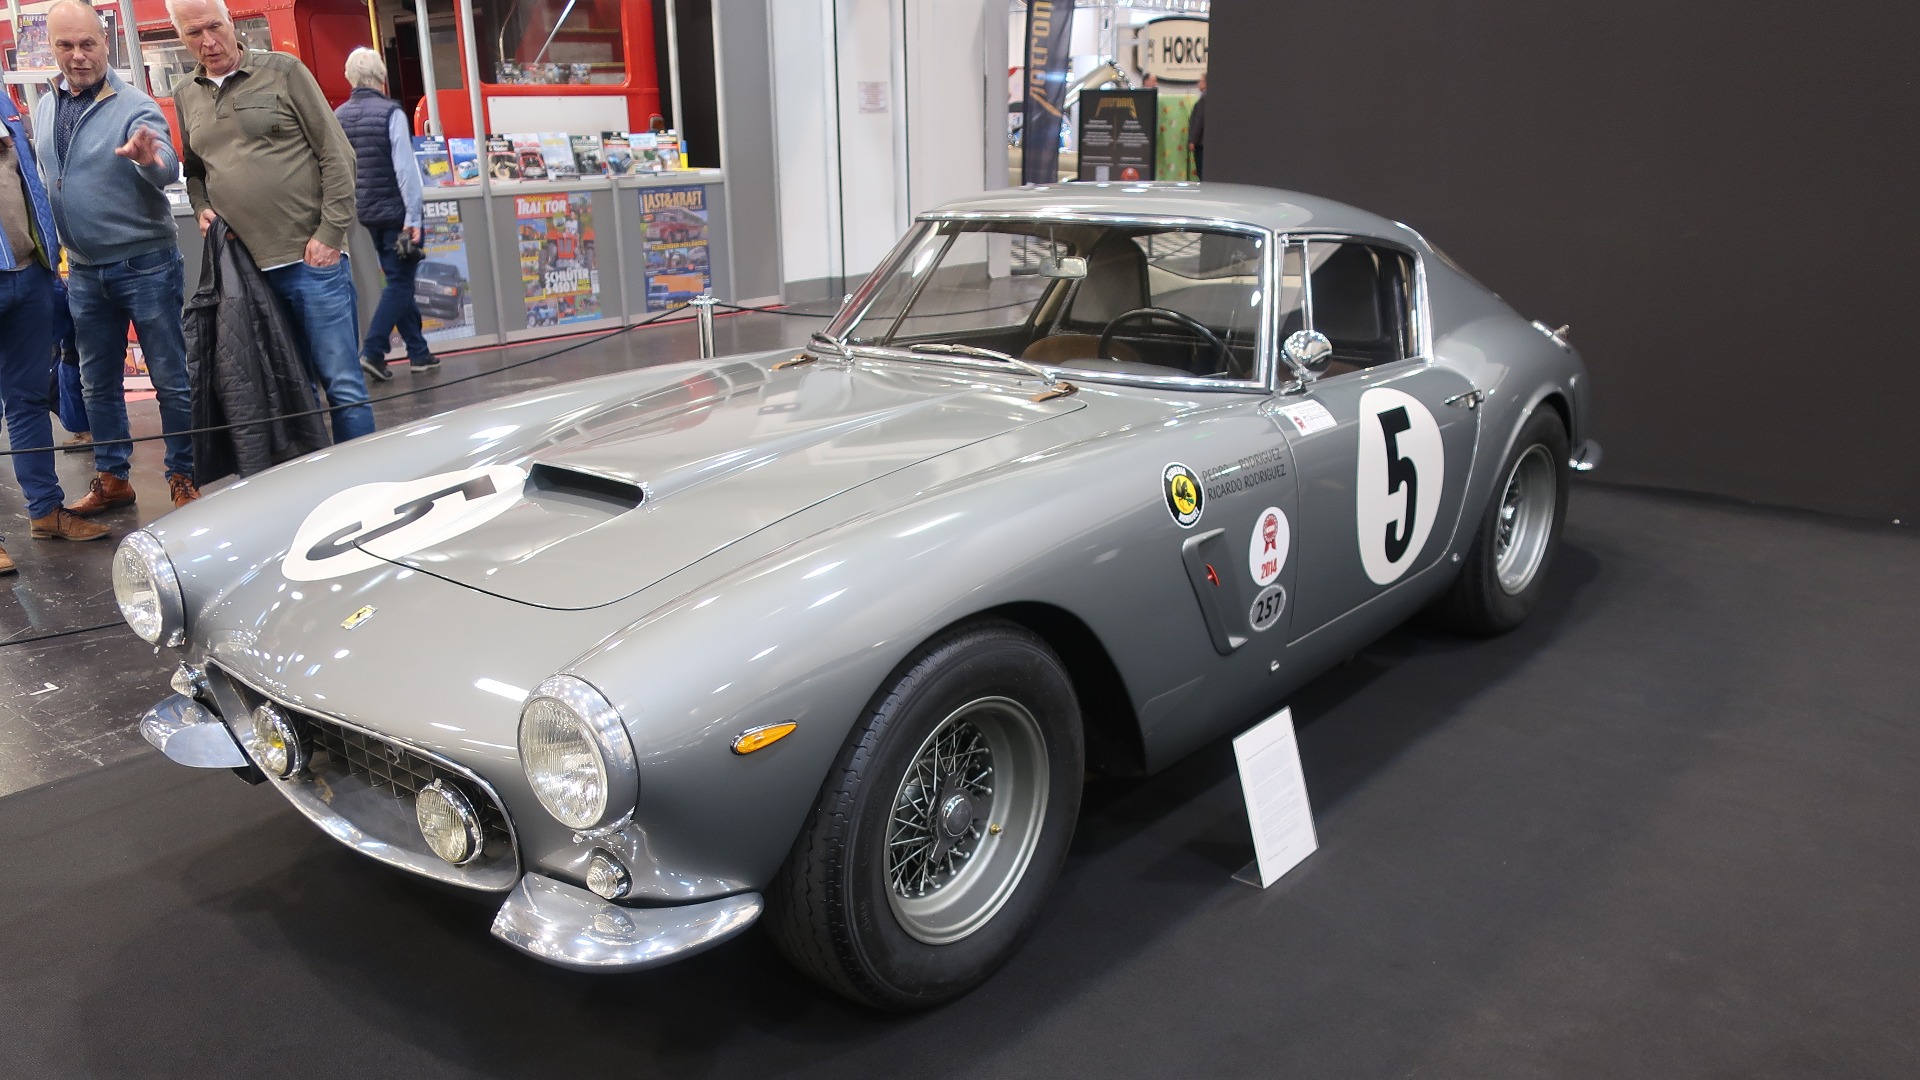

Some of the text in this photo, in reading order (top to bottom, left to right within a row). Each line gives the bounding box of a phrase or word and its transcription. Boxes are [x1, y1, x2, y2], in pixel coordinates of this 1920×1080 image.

[516, 197, 567, 216] TRAKTOR
[1201, 448, 1282, 484] PEDRO RODRIGUEZ
[1207, 463, 1287, 501] RICARDO RODRIGUEZ
[1377, 405, 1418, 564] 5
[305, 474, 496, 561] 5
[1260, 558, 1278, 580] 2014
[1255, 591, 1282, 623] 257
